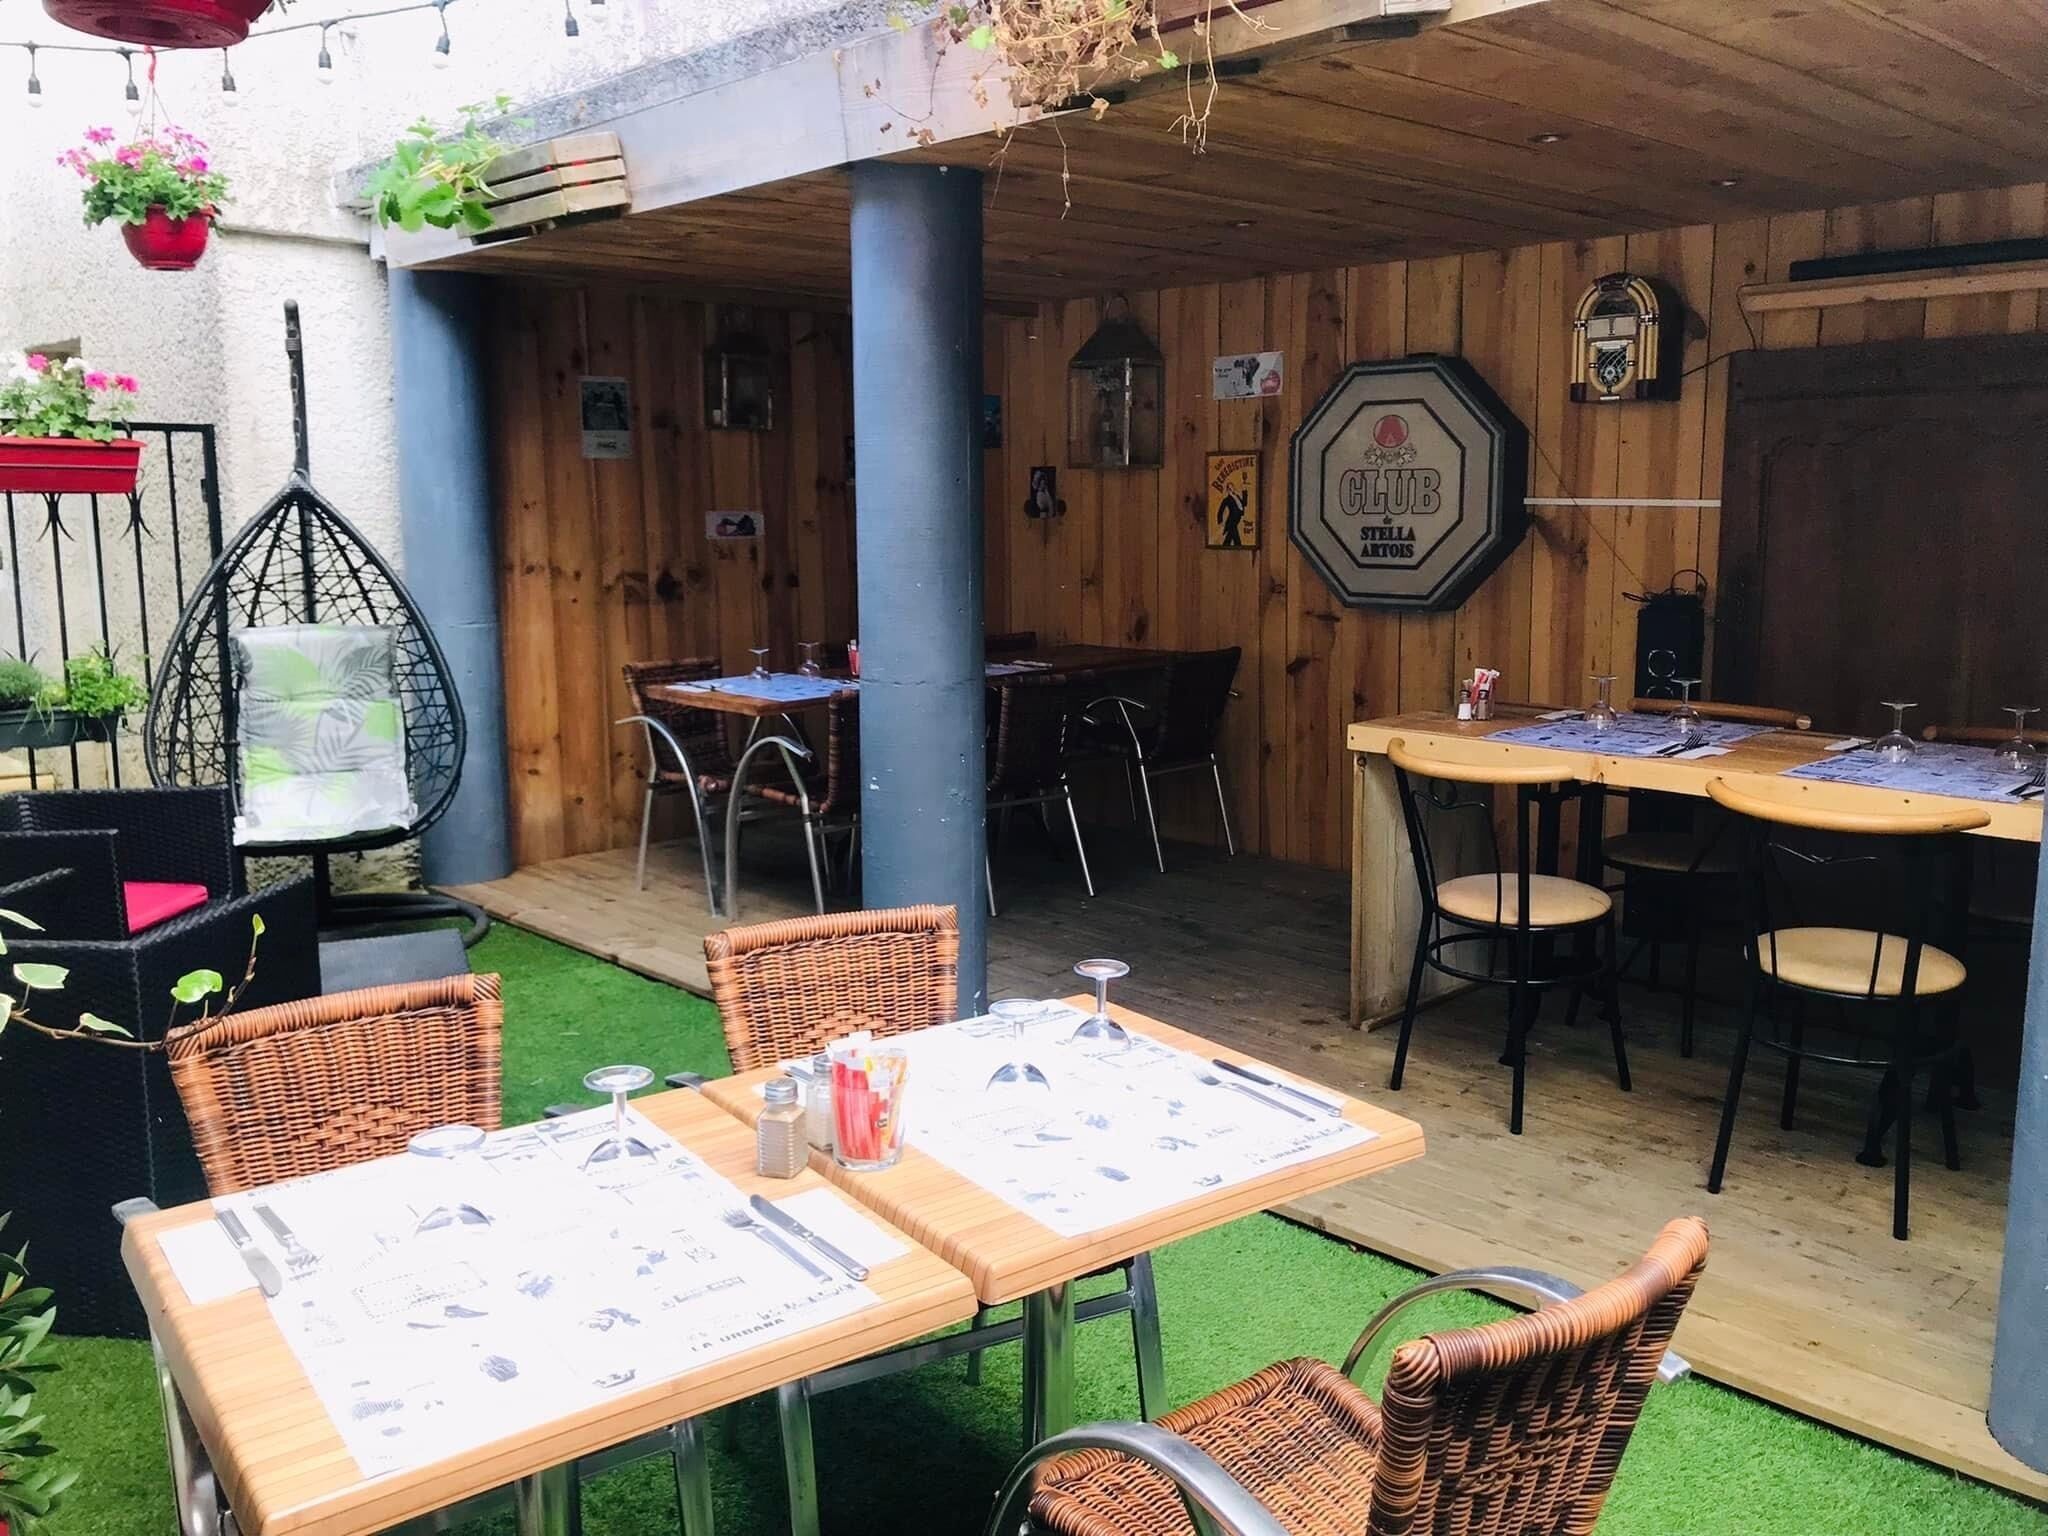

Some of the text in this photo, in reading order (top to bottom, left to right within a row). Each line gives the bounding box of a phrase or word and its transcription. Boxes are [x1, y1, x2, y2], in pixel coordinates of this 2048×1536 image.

[1339, 468, 1441, 516] CLUB
[1383, 515, 1393, 525] de
[1360, 526, 1416, 541] STELLA
[1360, 543, 1414, 558] ARTOIS
